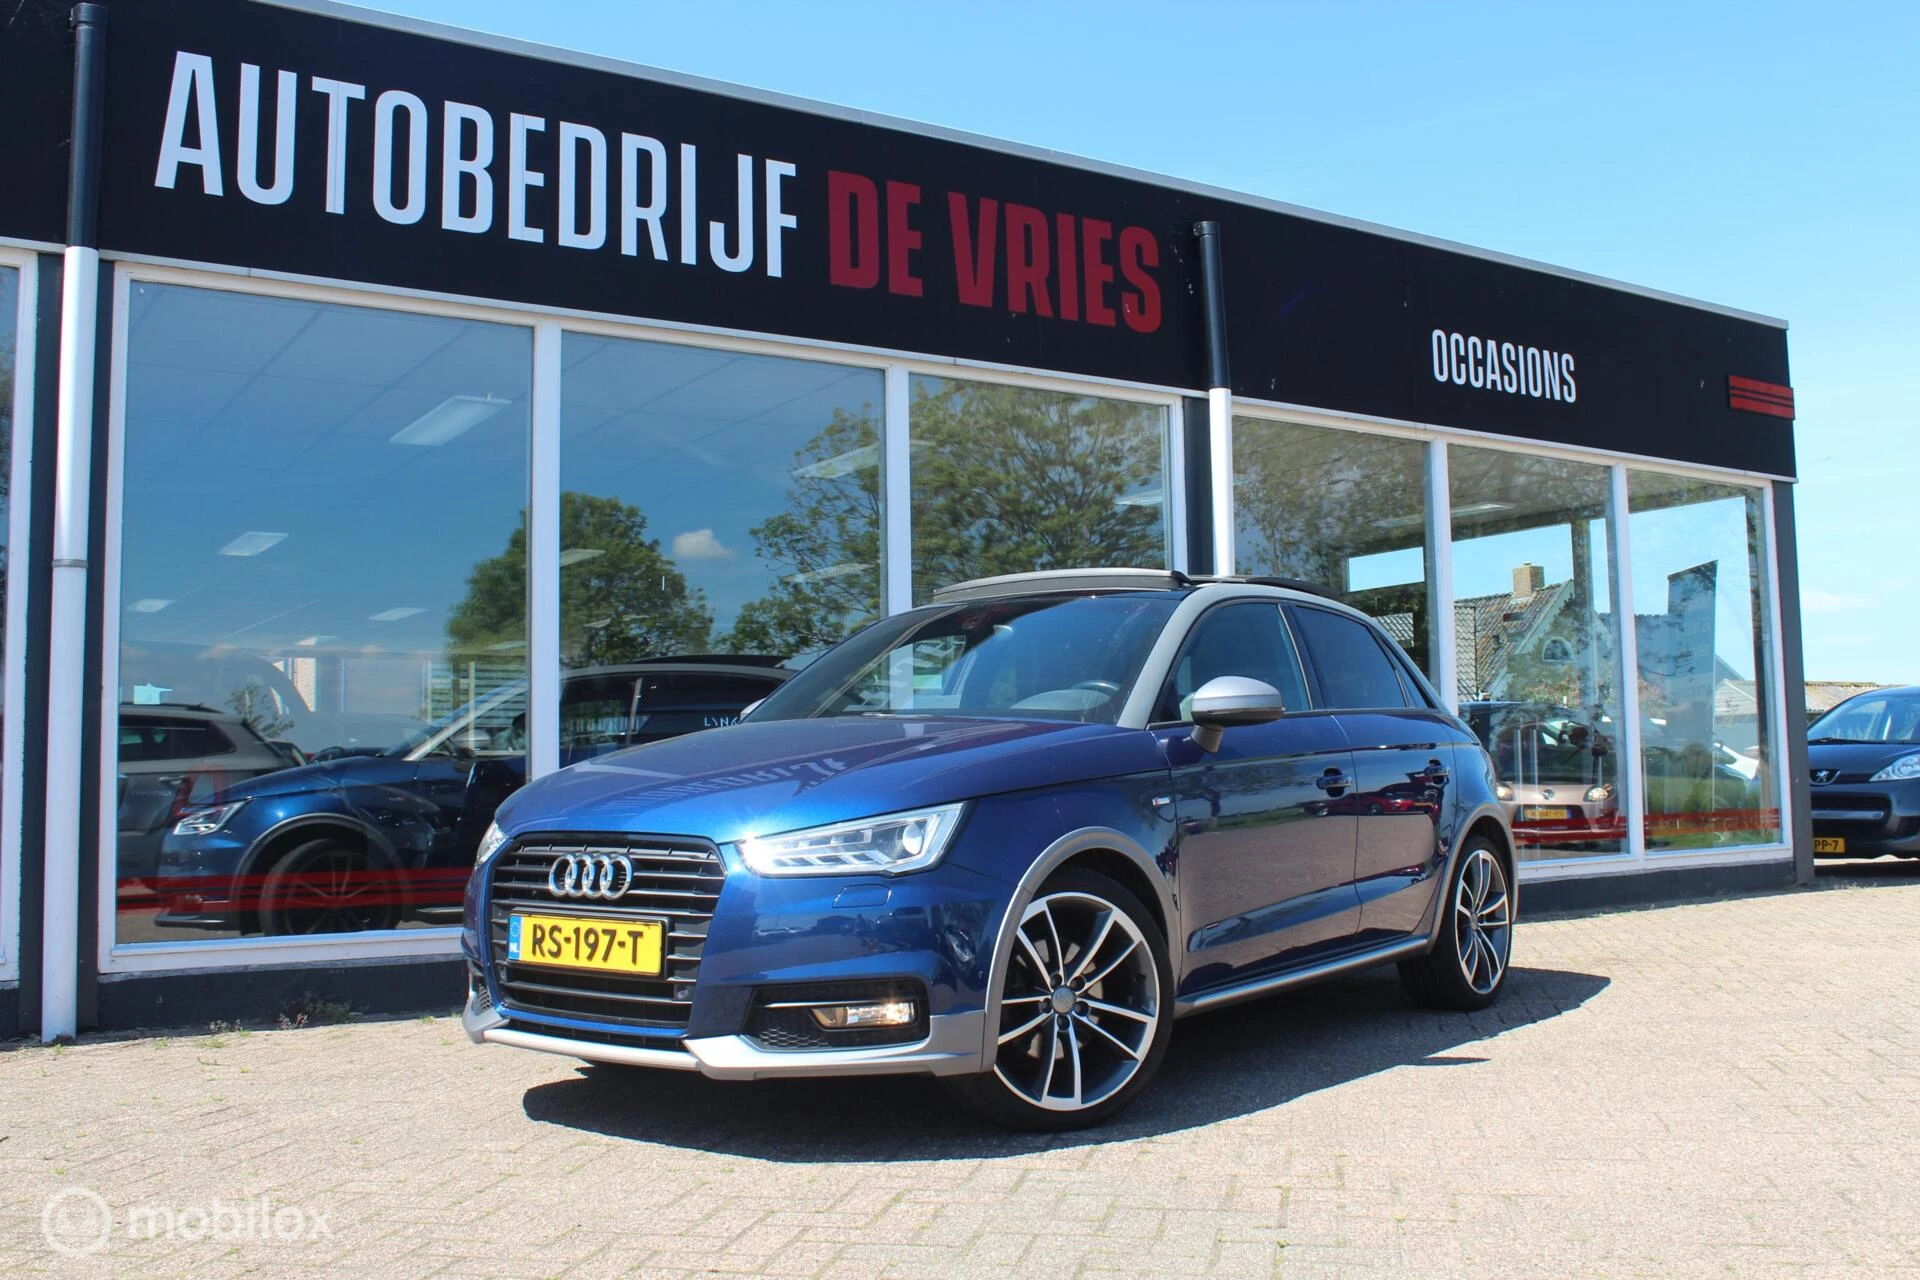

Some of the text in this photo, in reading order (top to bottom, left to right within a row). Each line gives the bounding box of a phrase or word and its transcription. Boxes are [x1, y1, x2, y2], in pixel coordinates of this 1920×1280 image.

[154, 51, 1163, 334] AUTOBEDRIJF DE VRIES
[1431, 329, 1577, 404] OCCASIONS
[532, 923, 644, 966] RS-197-T
